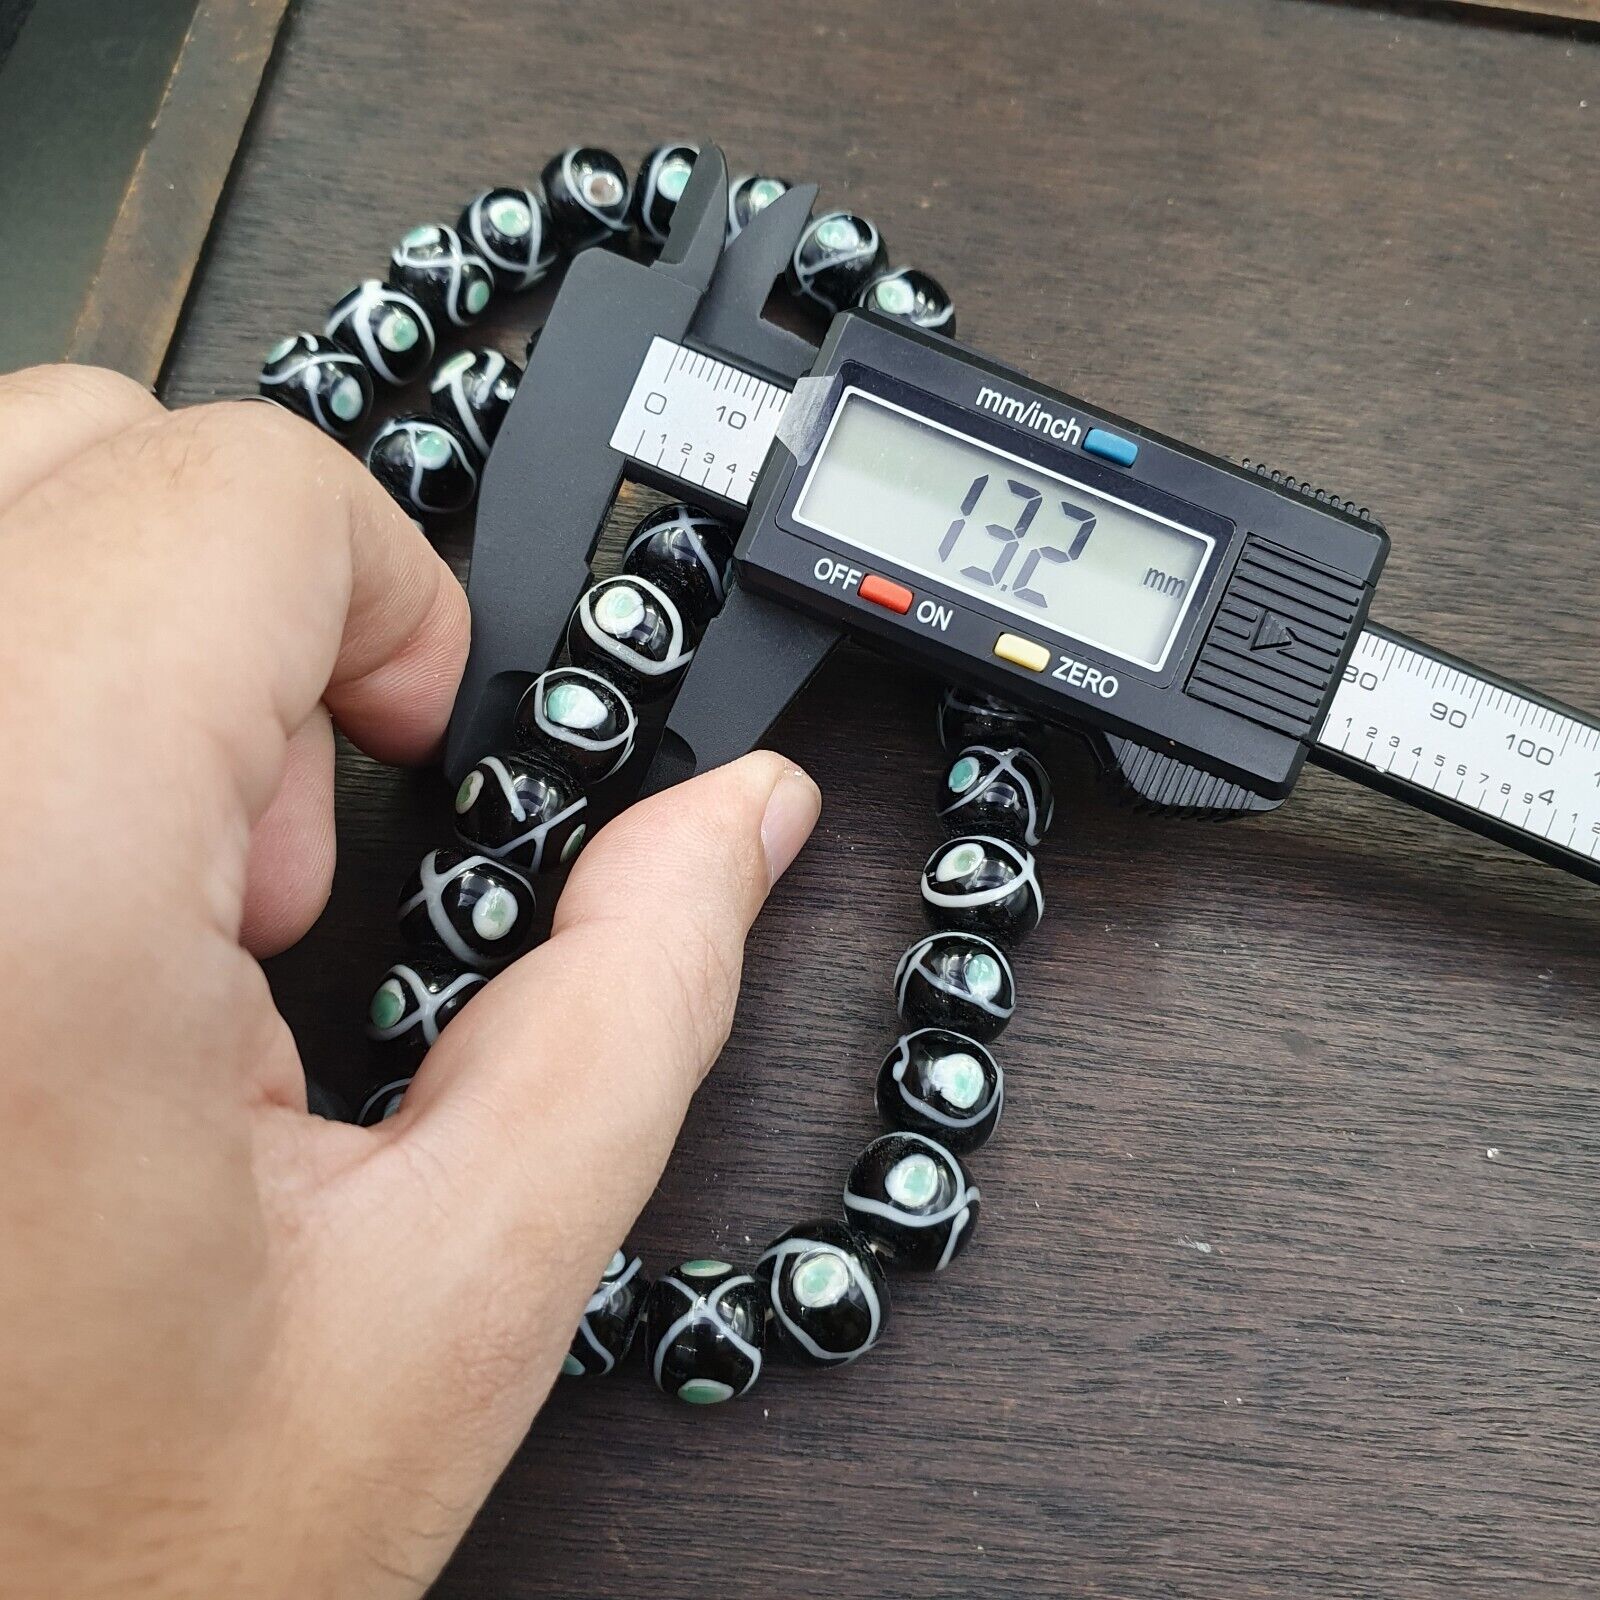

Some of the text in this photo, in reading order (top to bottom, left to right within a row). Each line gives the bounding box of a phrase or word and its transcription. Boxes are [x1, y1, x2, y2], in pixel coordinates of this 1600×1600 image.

[644, 391, 747, 430] 0 10
[975, 385, 1082, 446] mm/inch
[660, 434, 667, 444] 1
[680, 442, 693, 455] 2
[703, 452, 715, 465] 3
[726, 463, 737, 474] 4
[813, 557, 862, 590] OFF
[1143, 566, 1187, 599] mm
[916, 600, 954, 632] ON
[1051, 656, 1120, 700] ZERO
[1429, 702, 1467, 729] 90
[1505, 733, 1555, 766] 100
[1345, 717, 1354, 728] 1
[1366, 726, 1379, 739] 2
[1388, 735, 1401, 748] 3
[1411, 746, 1424, 758] 4
[1433, 754, 1446, 767] 5
[1456, 764, 1468, 777] 6
[1478, 772, 1490, 784] 7
[1500, 783, 1512, 795] 8
[1522, 792, 1534, 805] 9
[1538, 789, 1555, 806] 4
[1571, 812, 1579, 824] 1
